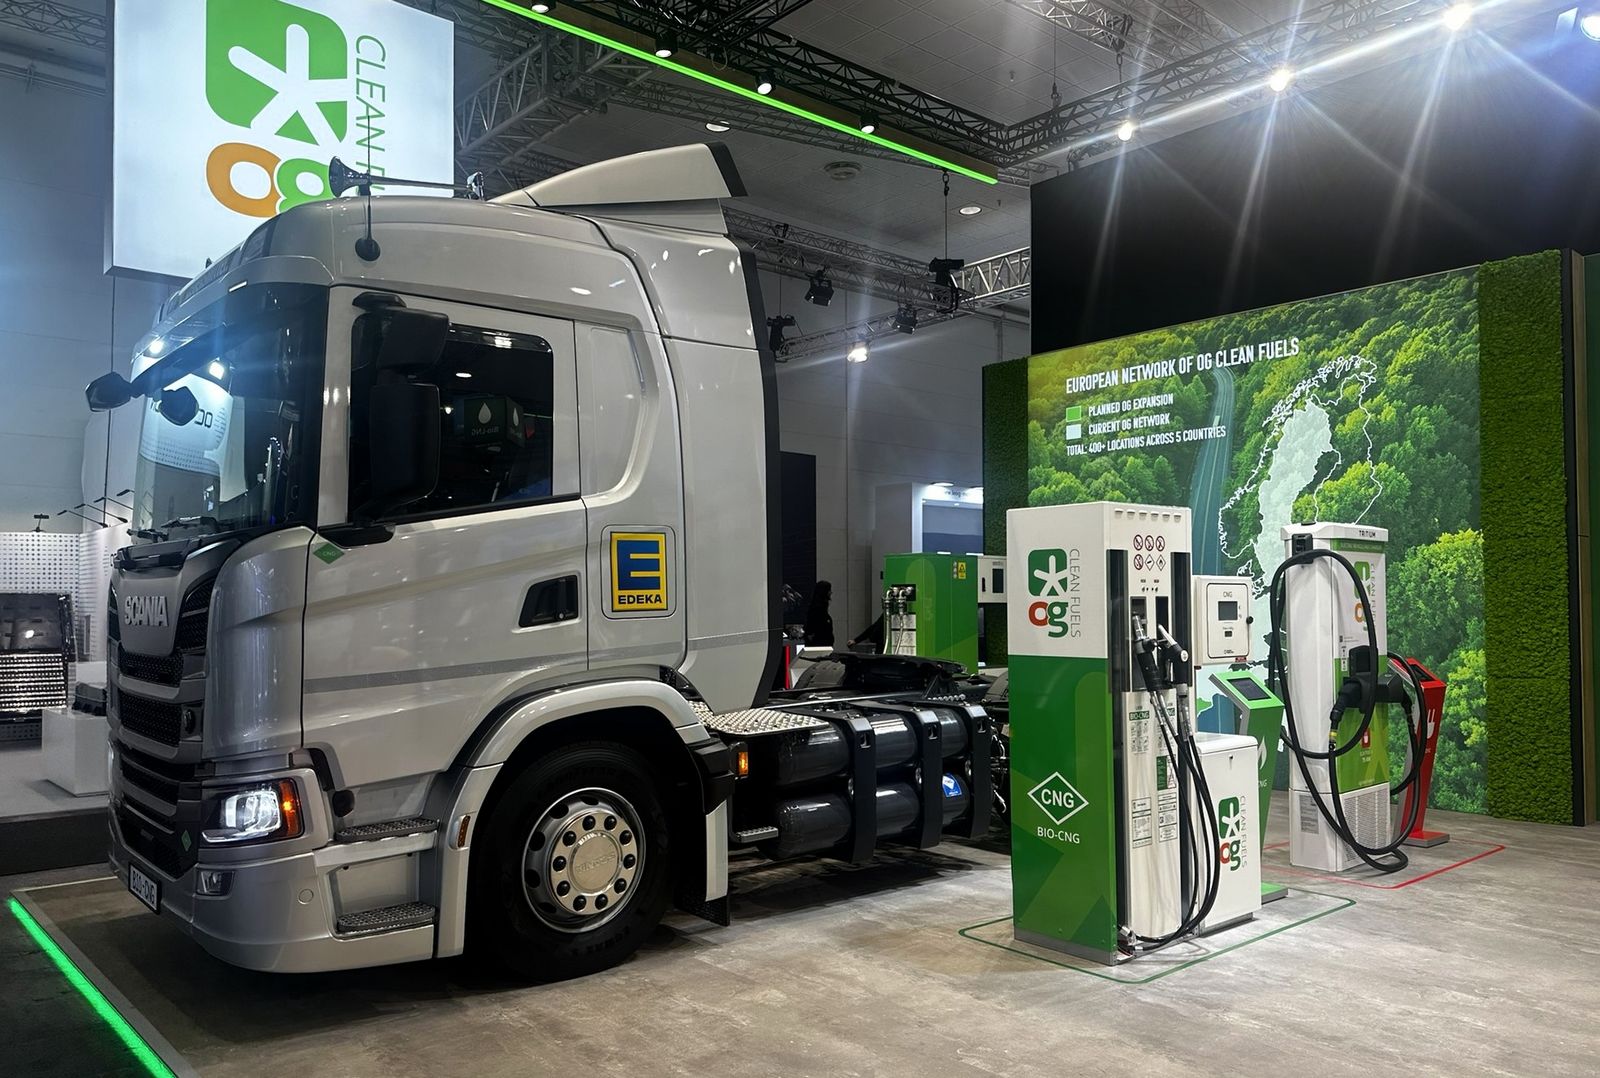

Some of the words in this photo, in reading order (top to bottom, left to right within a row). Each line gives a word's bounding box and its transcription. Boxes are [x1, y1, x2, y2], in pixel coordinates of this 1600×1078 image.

[355, 34, 386, 152] CLEAN
[1066, 369, 1119, 394] EUROPEAN
[1121, 359, 1176, 384] NETWORK
[1178, 355, 1194, 374] OF
[1196, 352, 1212, 371] OG
[1215, 344, 1254, 368] CLEAN
[1258, 337, 1300, 361] FUELS
[1088, 401, 1120, 417] PLANNED
[1121, 399, 1132, 412] OG
[1133, 393, 1174, 410] EXPANSION
[1088, 420, 1120, 435] CURRENT
[1121, 419, 1132, 431] OG
[1133, 412, 1170, 429] NETWORK
[1066, 445, 1087, 456] TOTAL:
[1088, 441, 1106, 454] 400+
[1107, 435, 1145, 451] LOCATIONS
[1145, 431, 1175, 447] ACROSS
[1175, 431, 1182, 442] 5
[1182, 425, 1226, 442] COUNTRIES
[1069, 548, 1080, 592] CLEAN
[124, 595, 170, 627] SCANIA
[617, 594, 663, 605] EDEKA
[1028, 601, 1069, 638] og
[1070, 596, 1082, 638] FUELS
[1129, 711, 1150, 720] BIO-CNG
[1041, 788, 1075, 809] CNG
[1037, 826, 1081, 844] BIO-CNG
